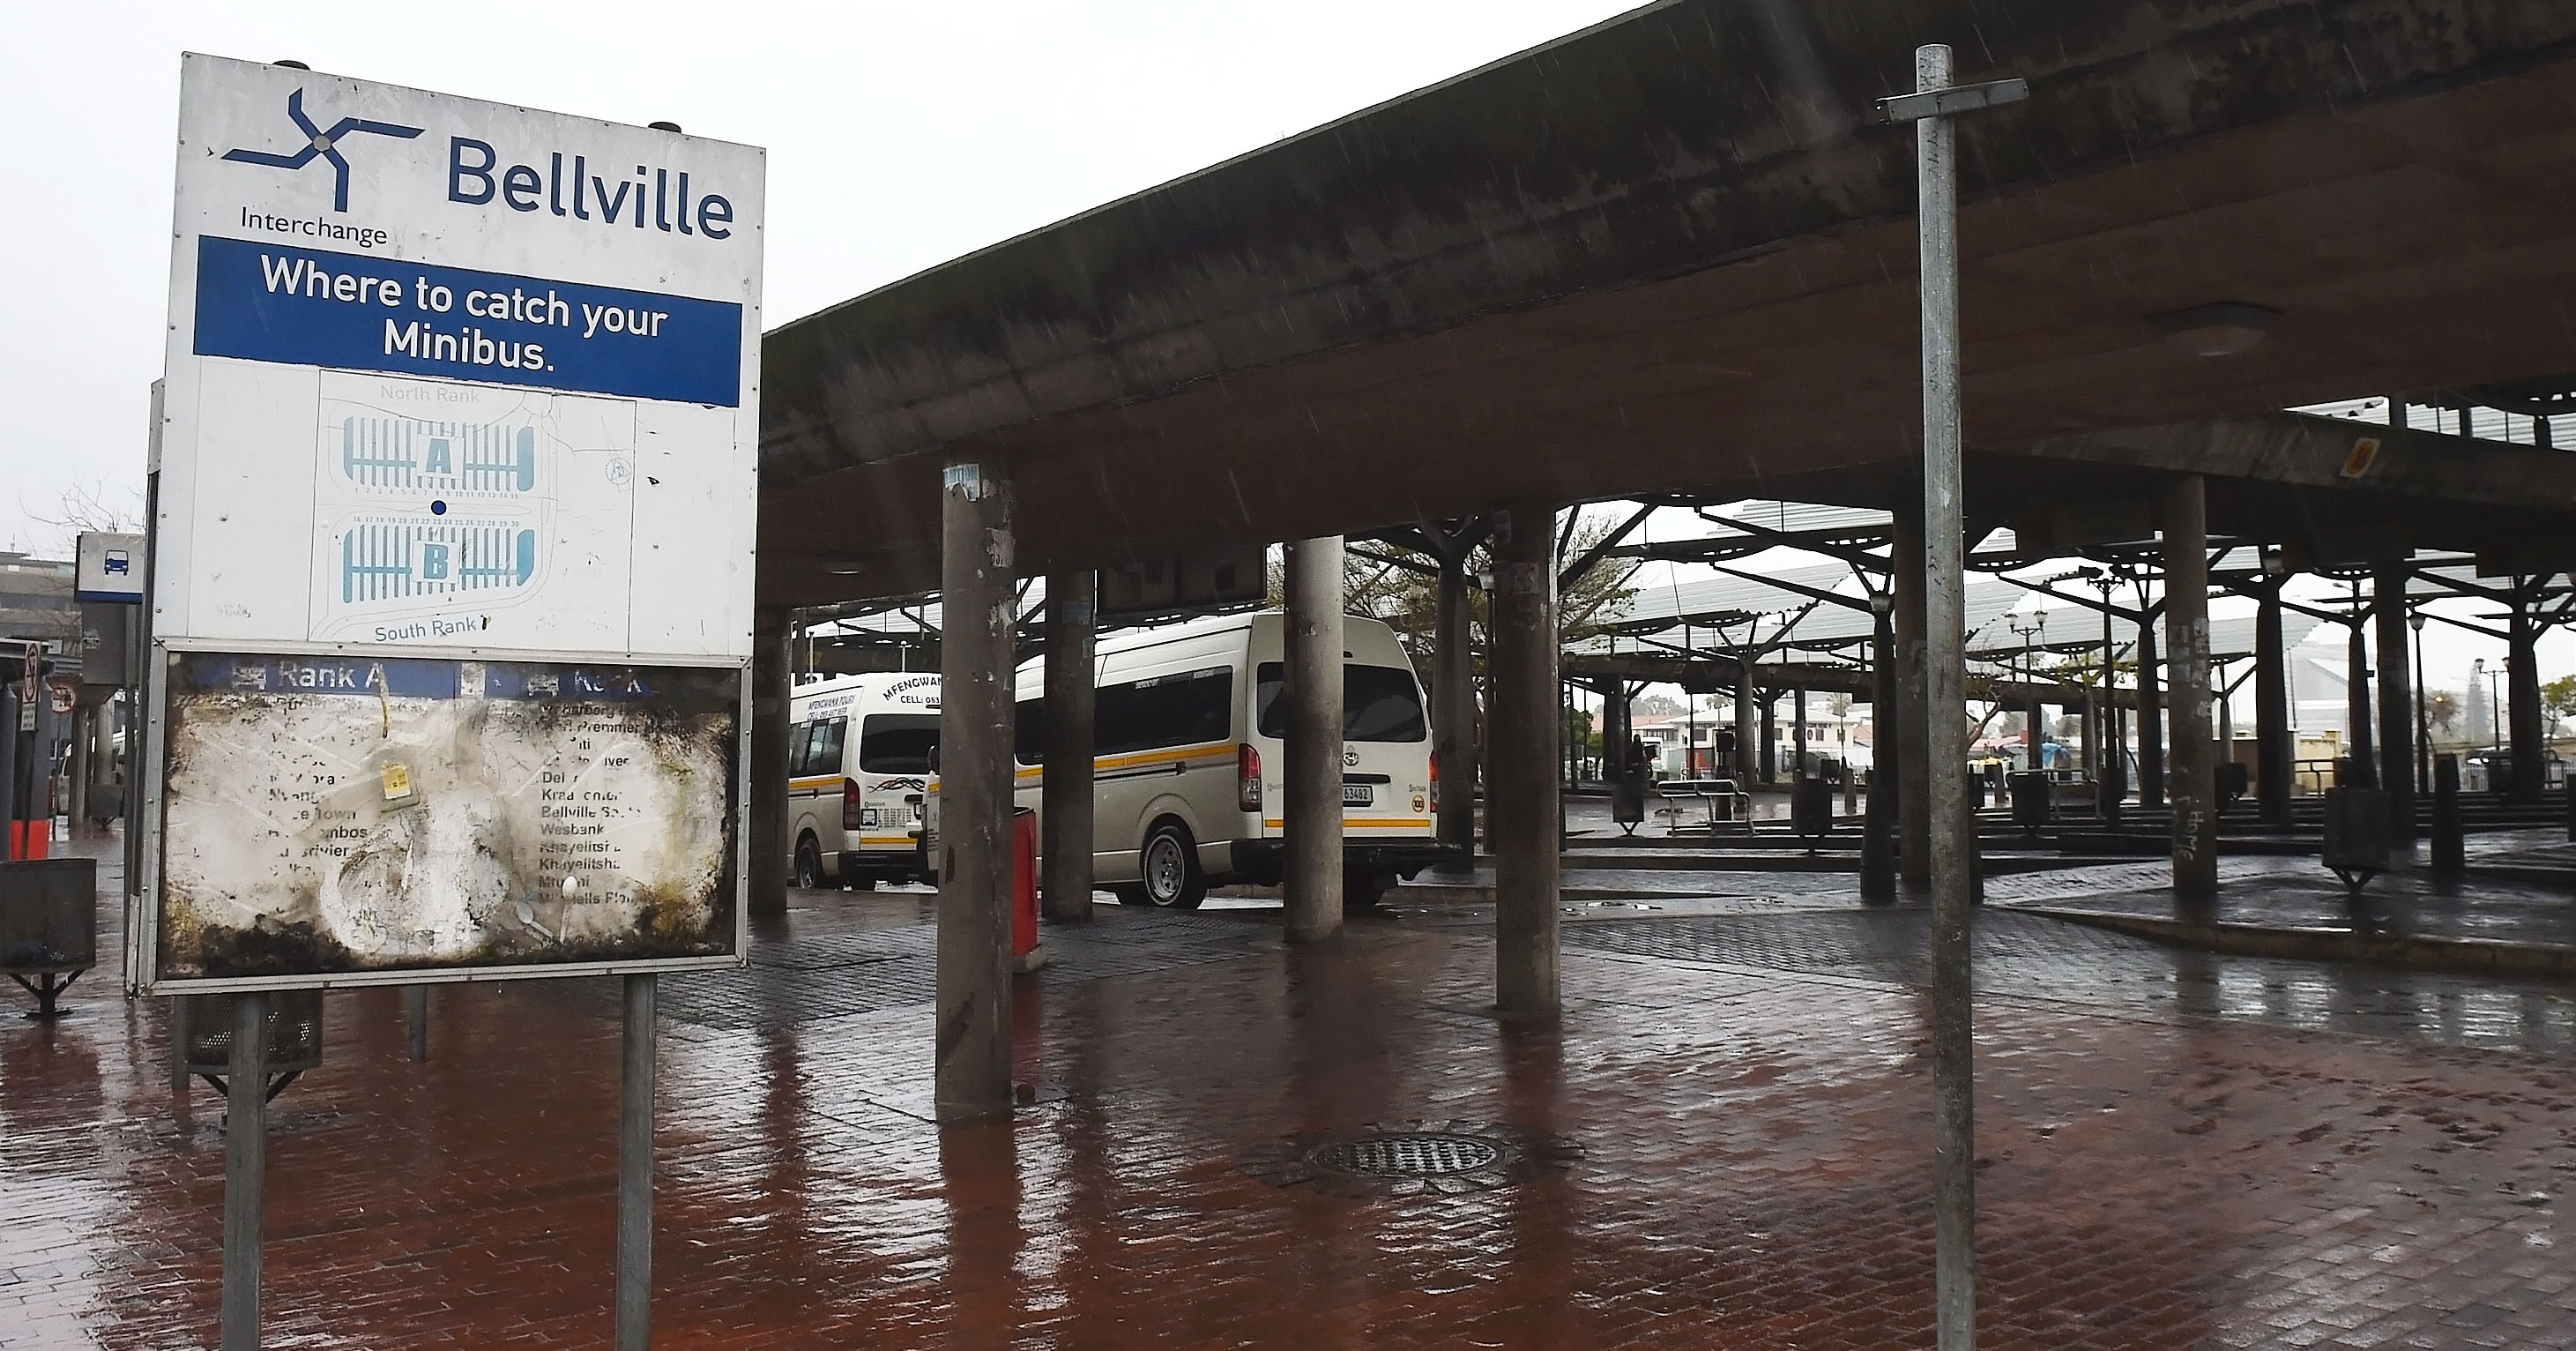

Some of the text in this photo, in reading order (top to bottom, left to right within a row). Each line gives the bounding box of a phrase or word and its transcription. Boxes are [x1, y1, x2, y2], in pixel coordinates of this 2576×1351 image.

[447, 135, 733, 240] Bellville
[240, 206, 388, 248] Interchange
[260, 254, 668, 340] Where to catch your
[383, 317, 555, 373] Minibus.
[381, 384, 480, 403] North Rank
[425, 438, 452, 474] A
[423, 543, 449, 579] B
[375, 616, 477, 642] South Rank
[278, 661, 357, 689] Rank
[900, 695, 923, 704] CELL:
[541, 824, 604, 835] Wesbank
